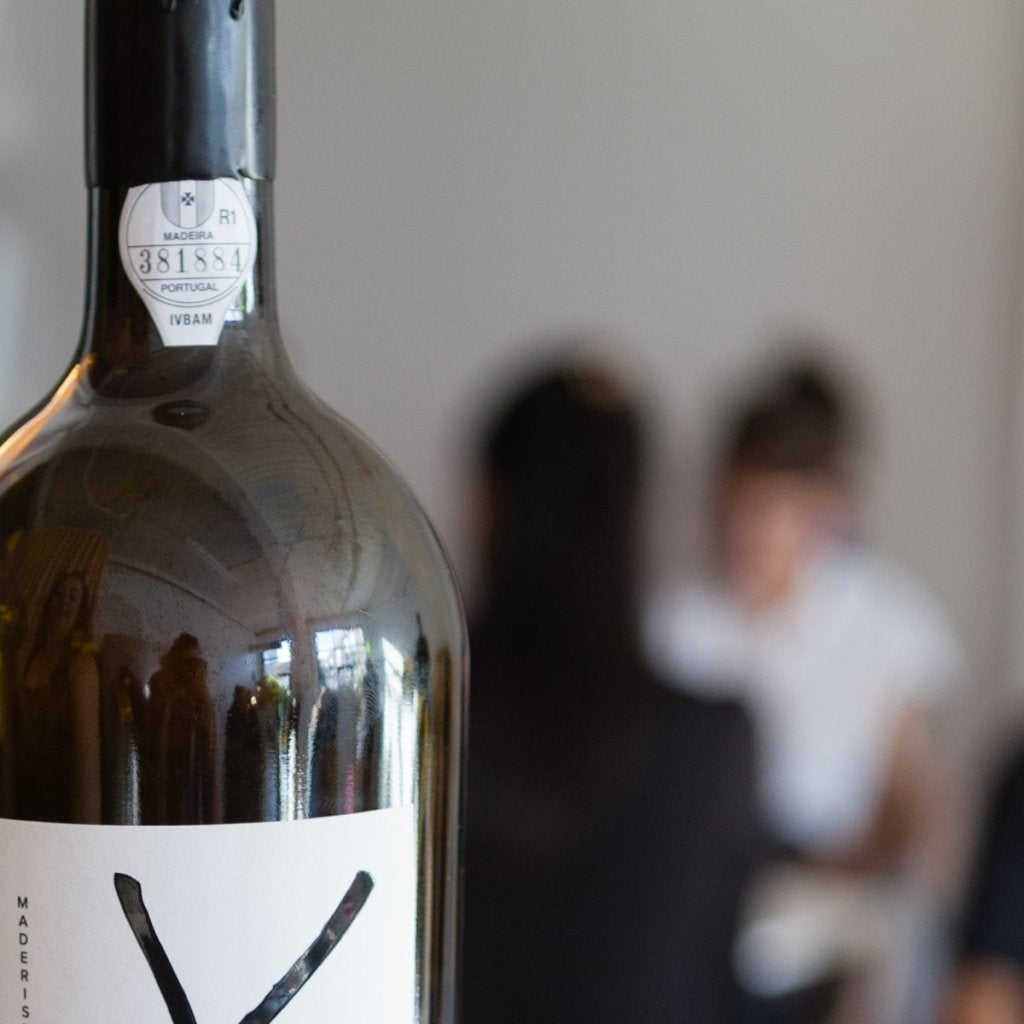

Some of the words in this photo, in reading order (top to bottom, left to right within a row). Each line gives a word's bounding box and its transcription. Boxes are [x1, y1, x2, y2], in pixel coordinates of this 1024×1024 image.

[219, 208, 236, 225] R1
[163, 231, 214, 241] MADEIRA
[139, 247, 241, 274] 381884
[161, 282, 218, 292] PORTUGAL
[170, 313, 213, 326] IVBAM
